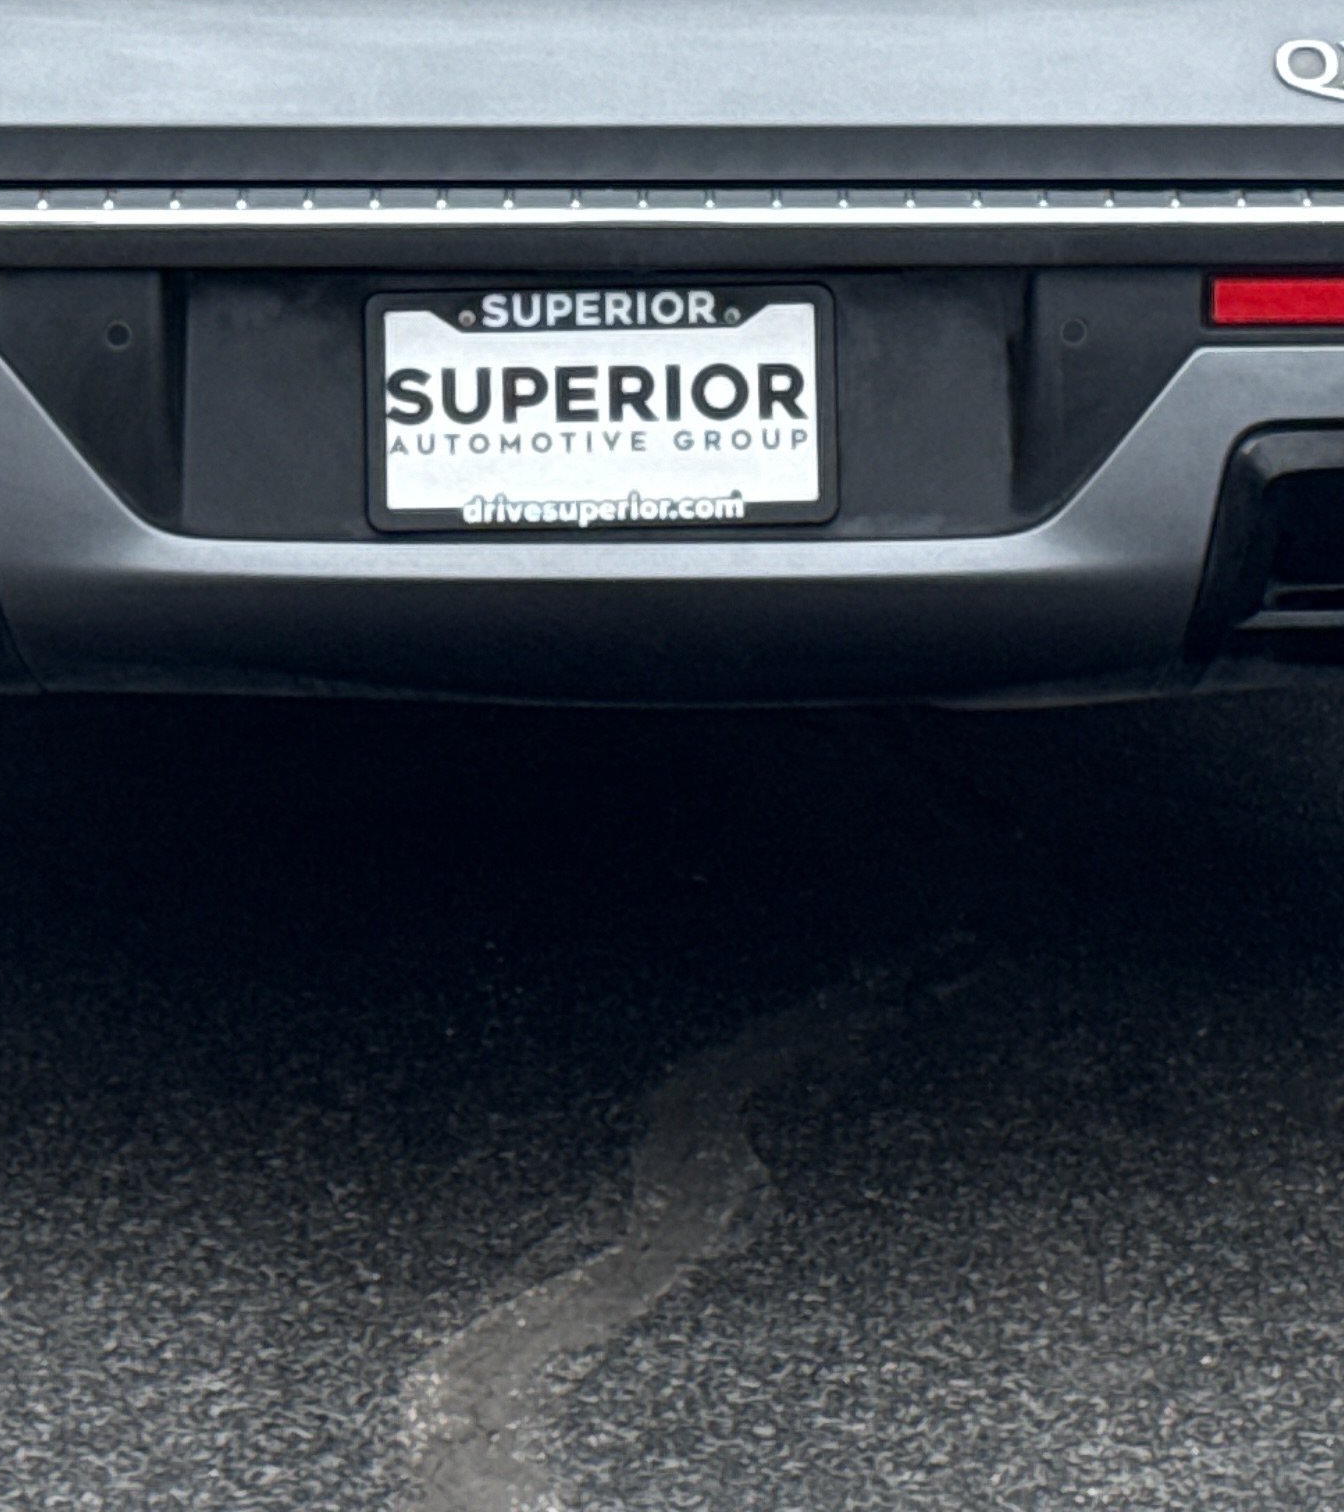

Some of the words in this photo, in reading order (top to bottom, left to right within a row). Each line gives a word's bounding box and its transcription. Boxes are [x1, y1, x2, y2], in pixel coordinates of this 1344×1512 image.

[481, 290, 717, 328] SUPERIOR
[386, 362, 809, 426] SUPERIOR
[389, 429, 649, 456] AUTOMOTIVE
[673, 427, 809, 452] GROUP
[462, 490, 746, 528] drivesuperior.com
